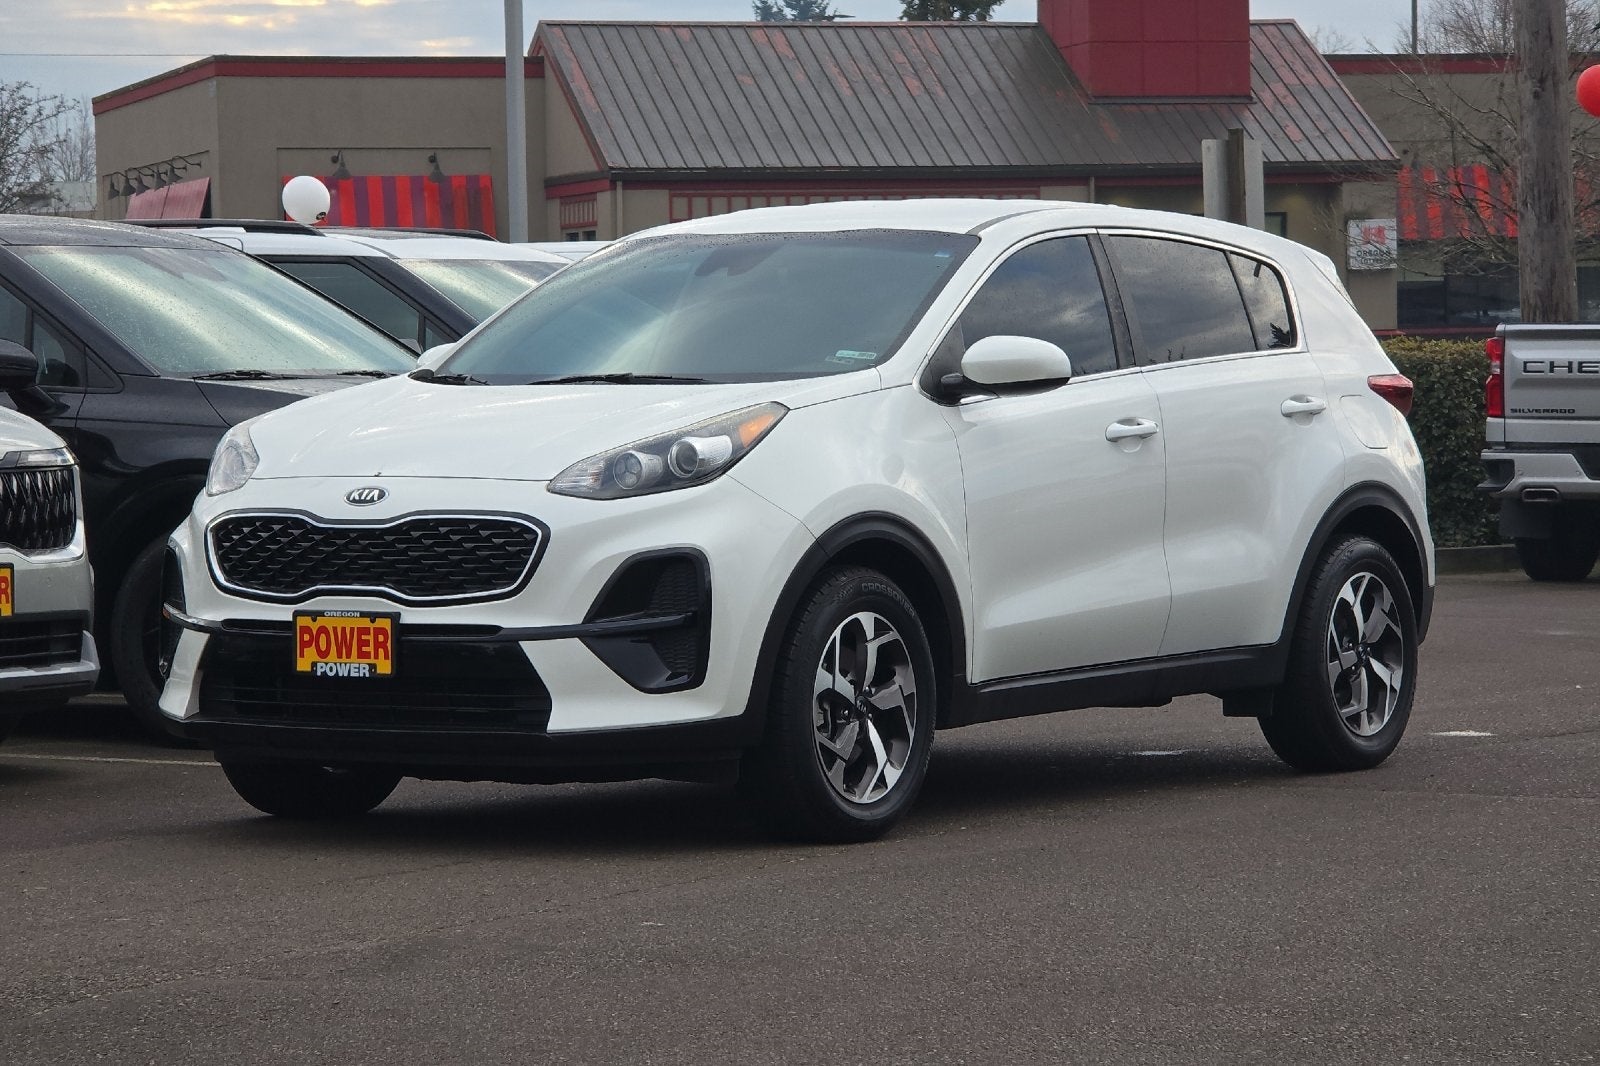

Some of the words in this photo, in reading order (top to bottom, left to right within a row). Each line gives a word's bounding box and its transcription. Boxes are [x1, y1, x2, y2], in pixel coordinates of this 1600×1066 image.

[349, 489, 380, 501] KIA
[298, 625, 390, 661] POWER
[316, 662, 370, 678] POWER
